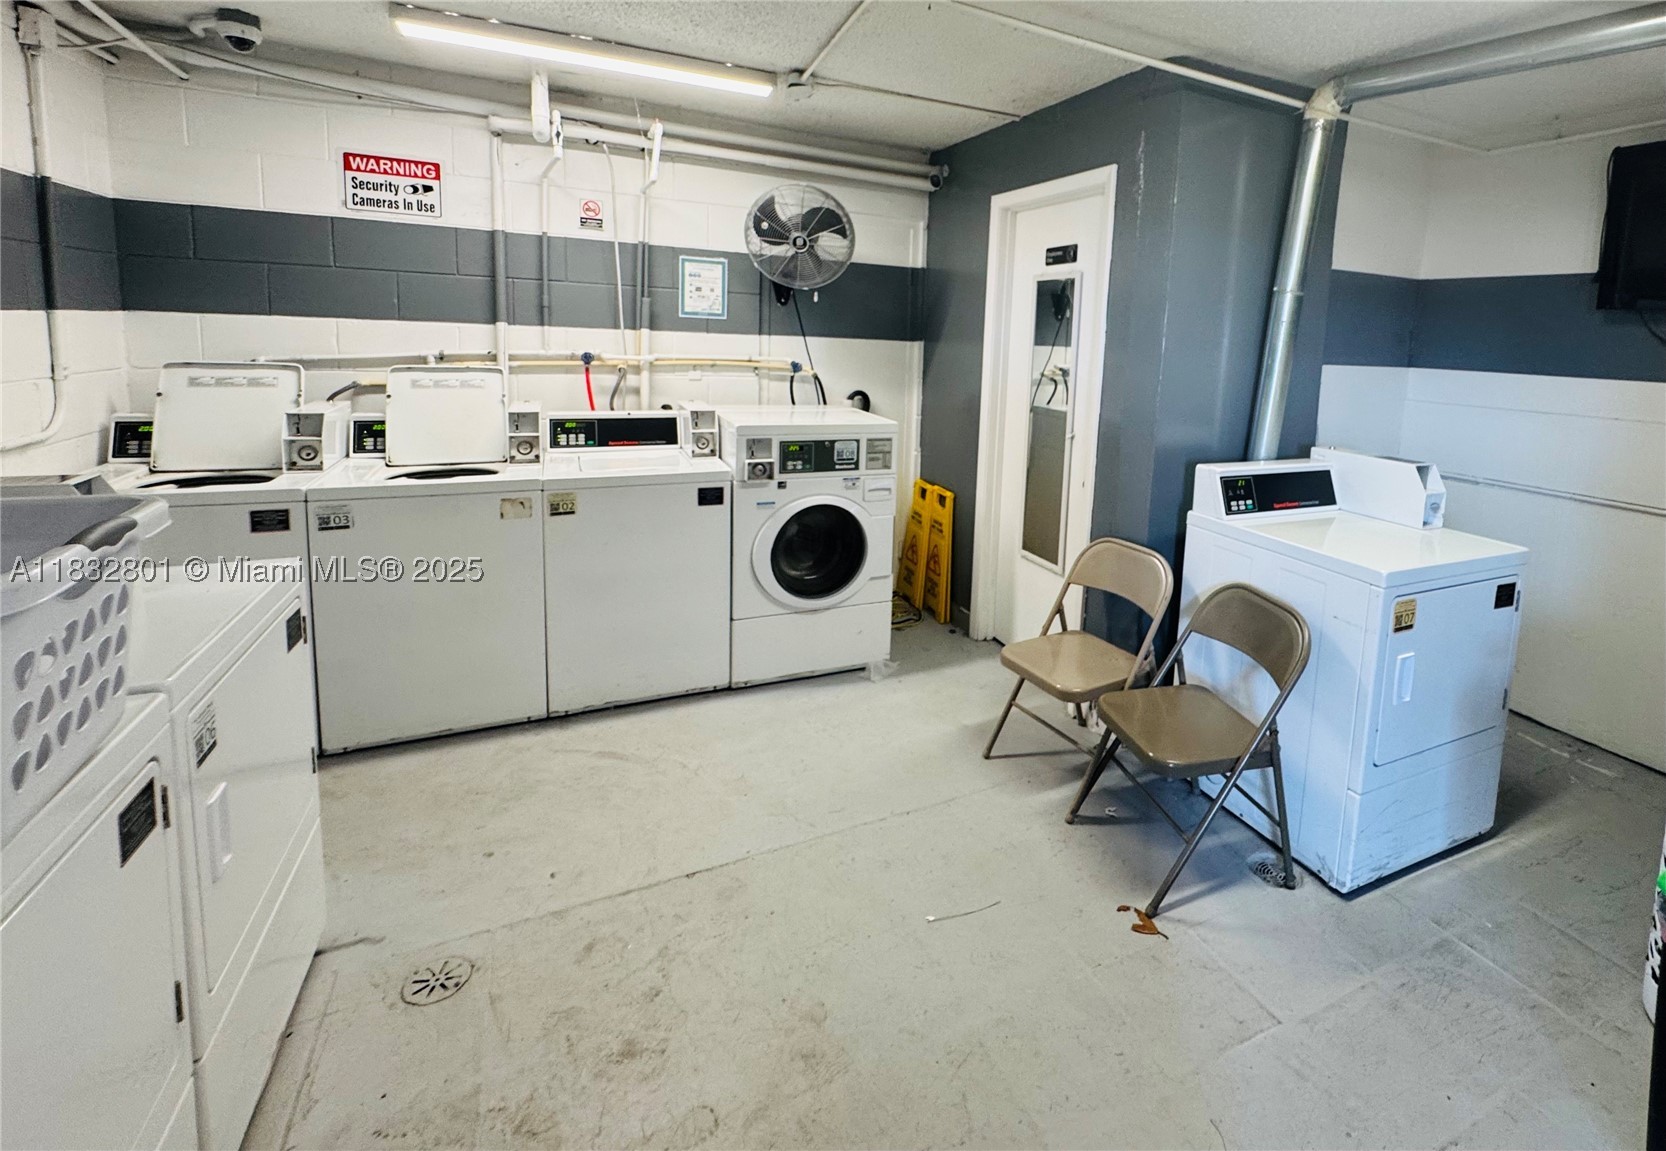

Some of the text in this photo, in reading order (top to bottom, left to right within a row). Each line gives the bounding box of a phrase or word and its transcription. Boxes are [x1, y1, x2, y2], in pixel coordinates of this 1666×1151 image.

[348, 155, 437, 179] WARNING
[351, 176, 400, 196] Security
[352, 192, 436, 213] Cameras In Use
[561, 502, 575, 511] 02
[332, 515, 350, 525] 03
[1403, 612, 1416, 625] 07
